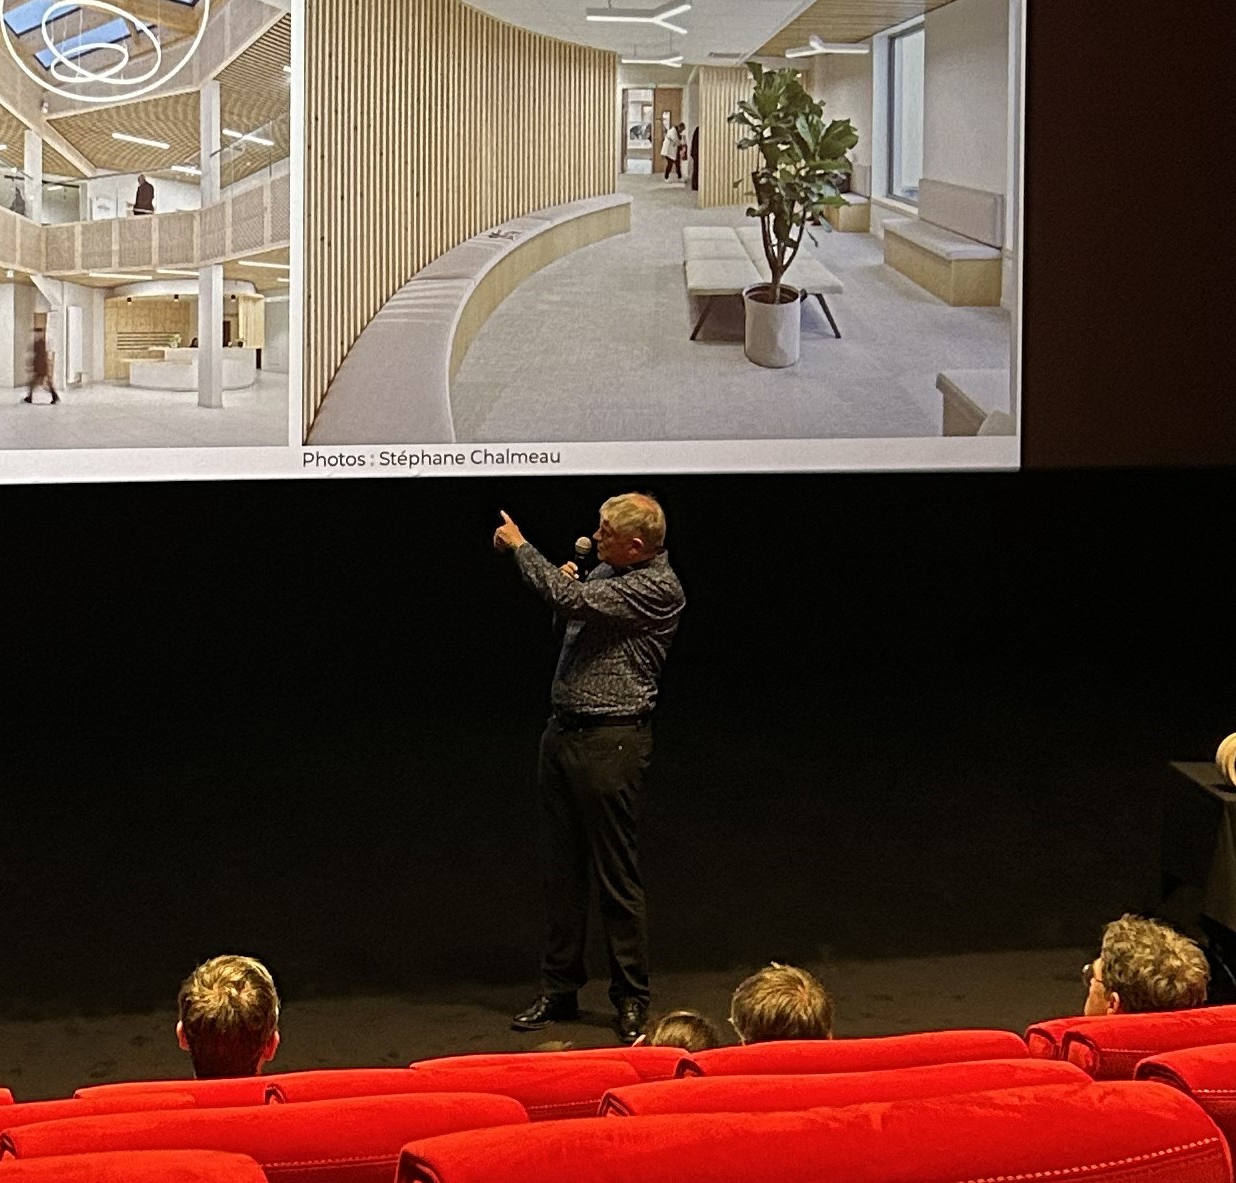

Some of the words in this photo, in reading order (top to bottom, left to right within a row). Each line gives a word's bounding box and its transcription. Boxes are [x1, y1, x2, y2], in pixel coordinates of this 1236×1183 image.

[303, 452, 366, 467] Photos
[379, 449, 465, 469] Stéphane
[470, 448, 561, 465] Chalmeau
